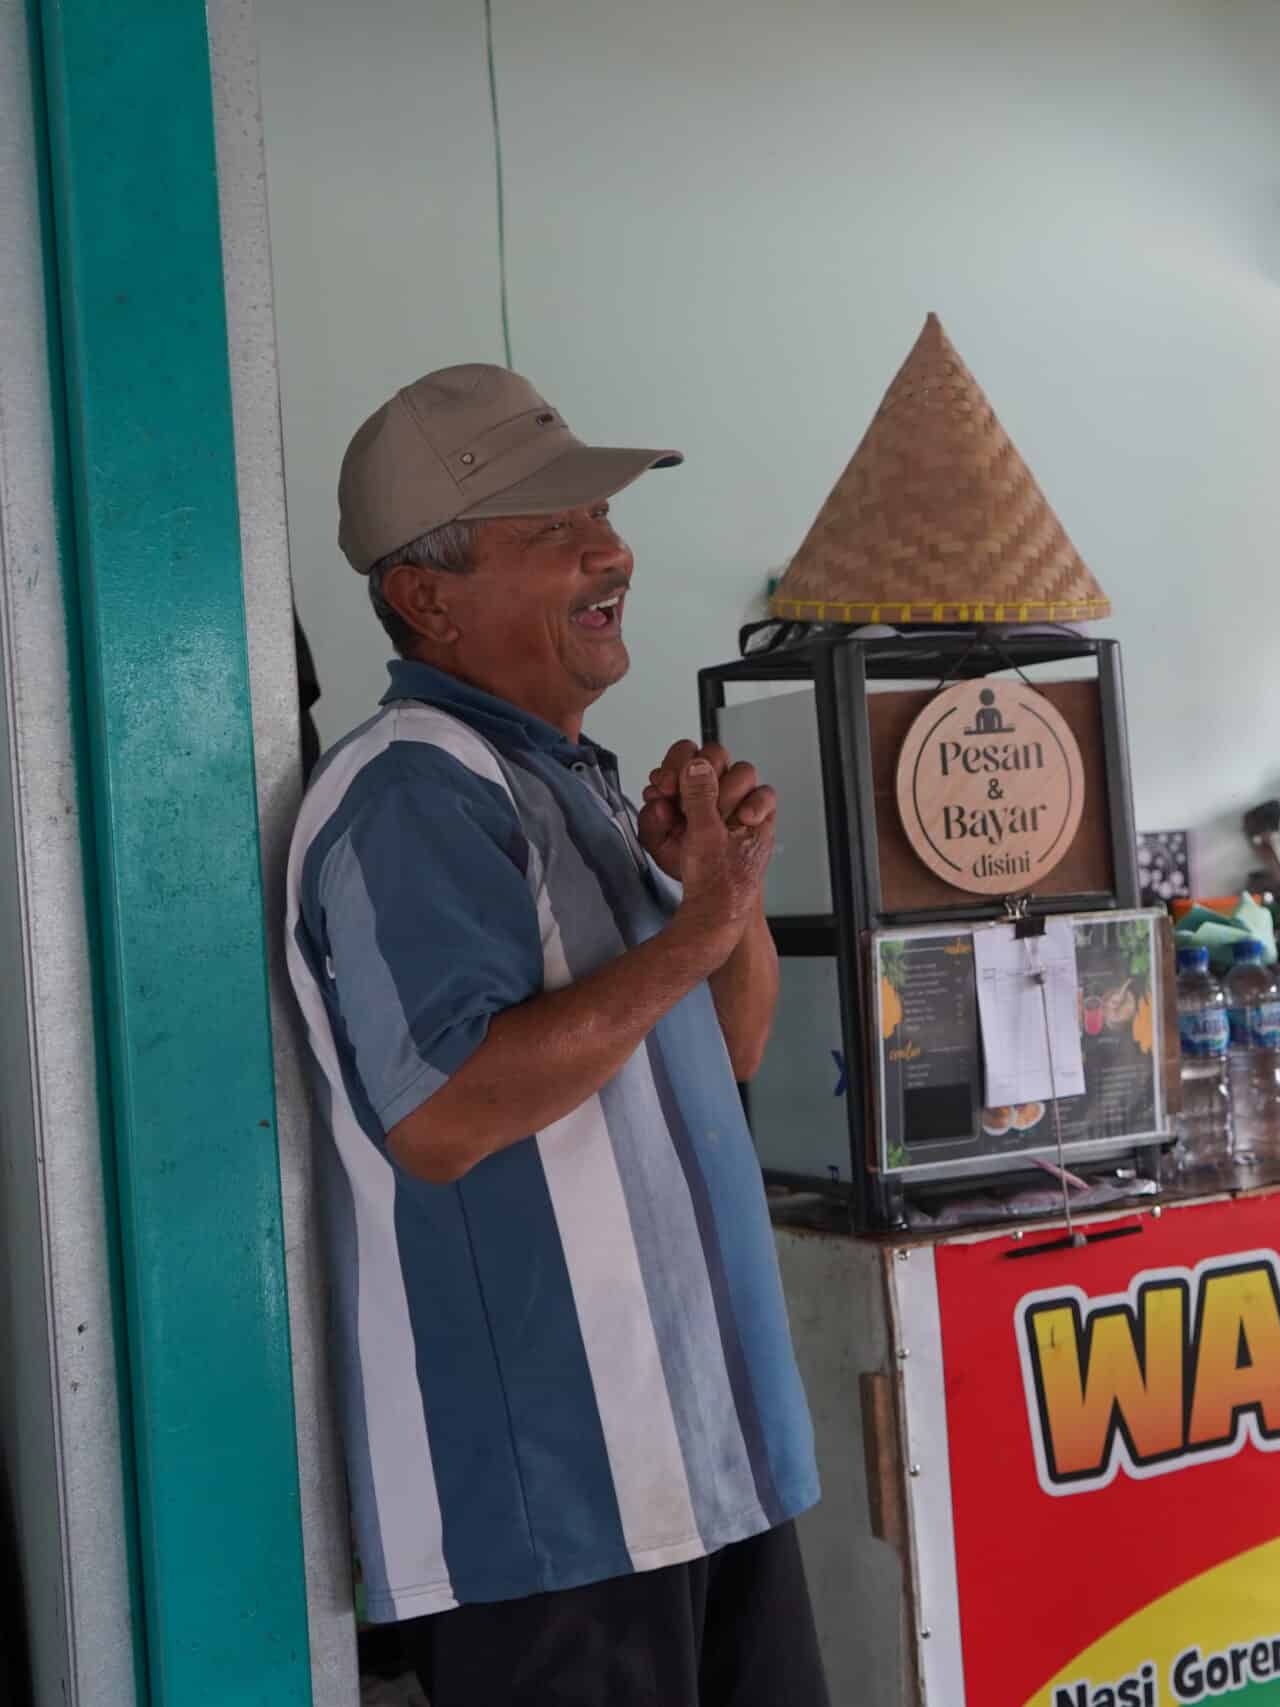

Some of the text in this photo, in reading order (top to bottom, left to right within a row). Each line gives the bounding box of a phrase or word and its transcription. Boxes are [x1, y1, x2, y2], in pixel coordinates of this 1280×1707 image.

[938, 740, 1045, 776] Pesan
[987, 778, 1004, 800] &
[943, 804, 1047, 845] Bayar
[972, 851, 1031, 879] disini
[1055, 1665, 1154, 1707] Nasi
